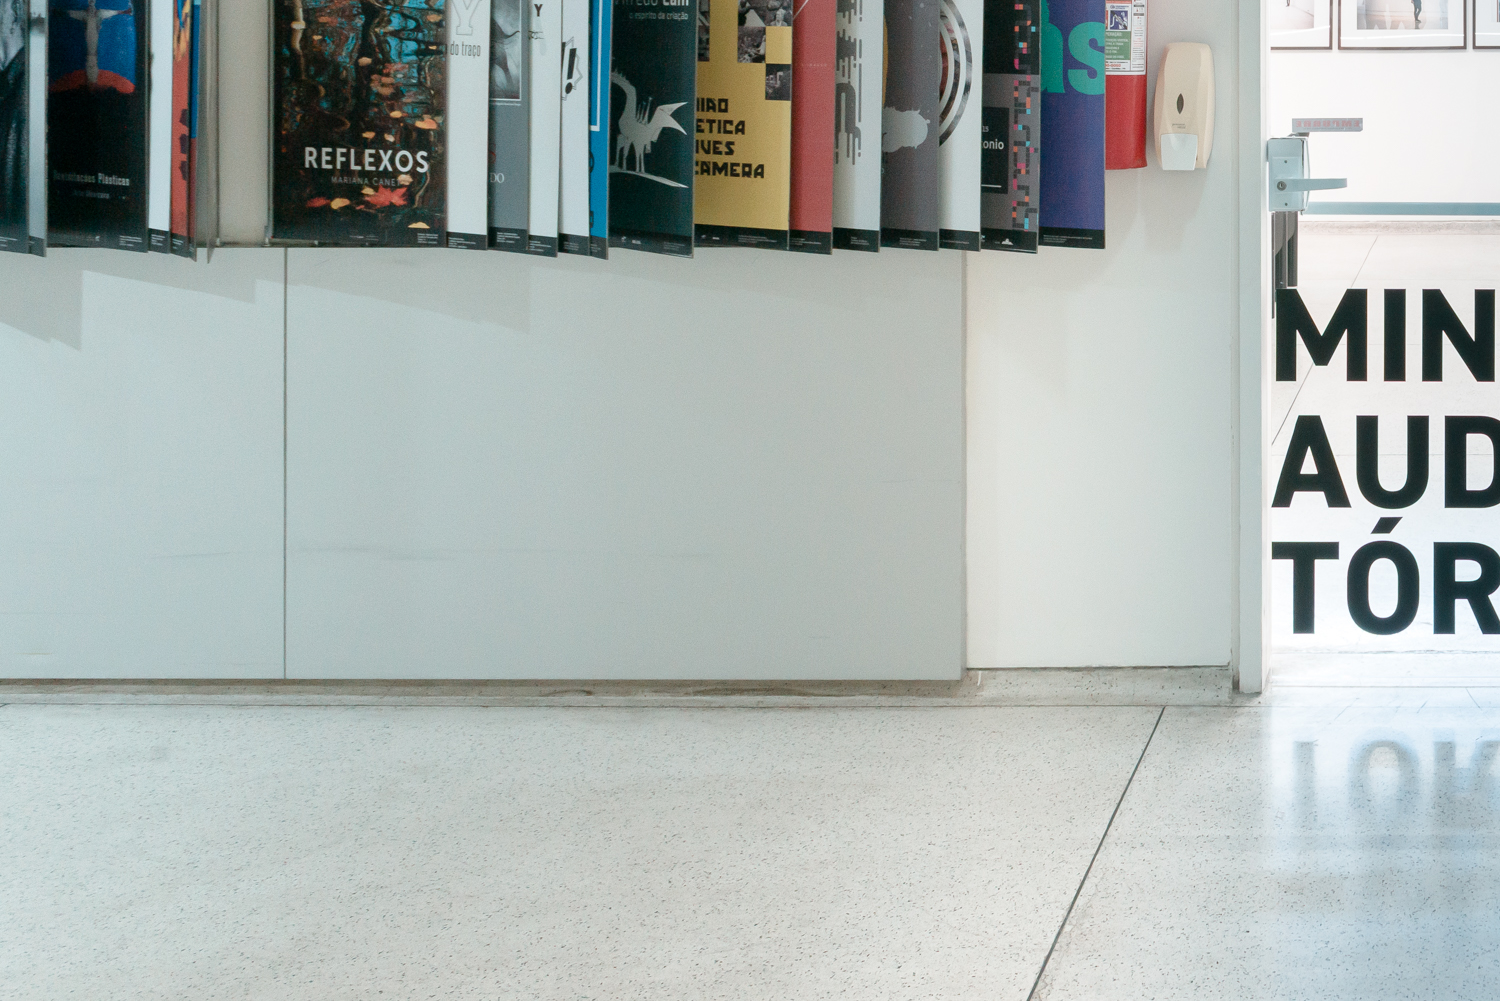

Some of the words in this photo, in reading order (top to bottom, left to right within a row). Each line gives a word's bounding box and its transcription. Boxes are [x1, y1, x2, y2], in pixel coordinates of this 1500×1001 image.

[461, 40, 482, 59] traço
[304, 146, 429, 173] REFLEXOS
[331, 175, 369, 185] MARIANA
